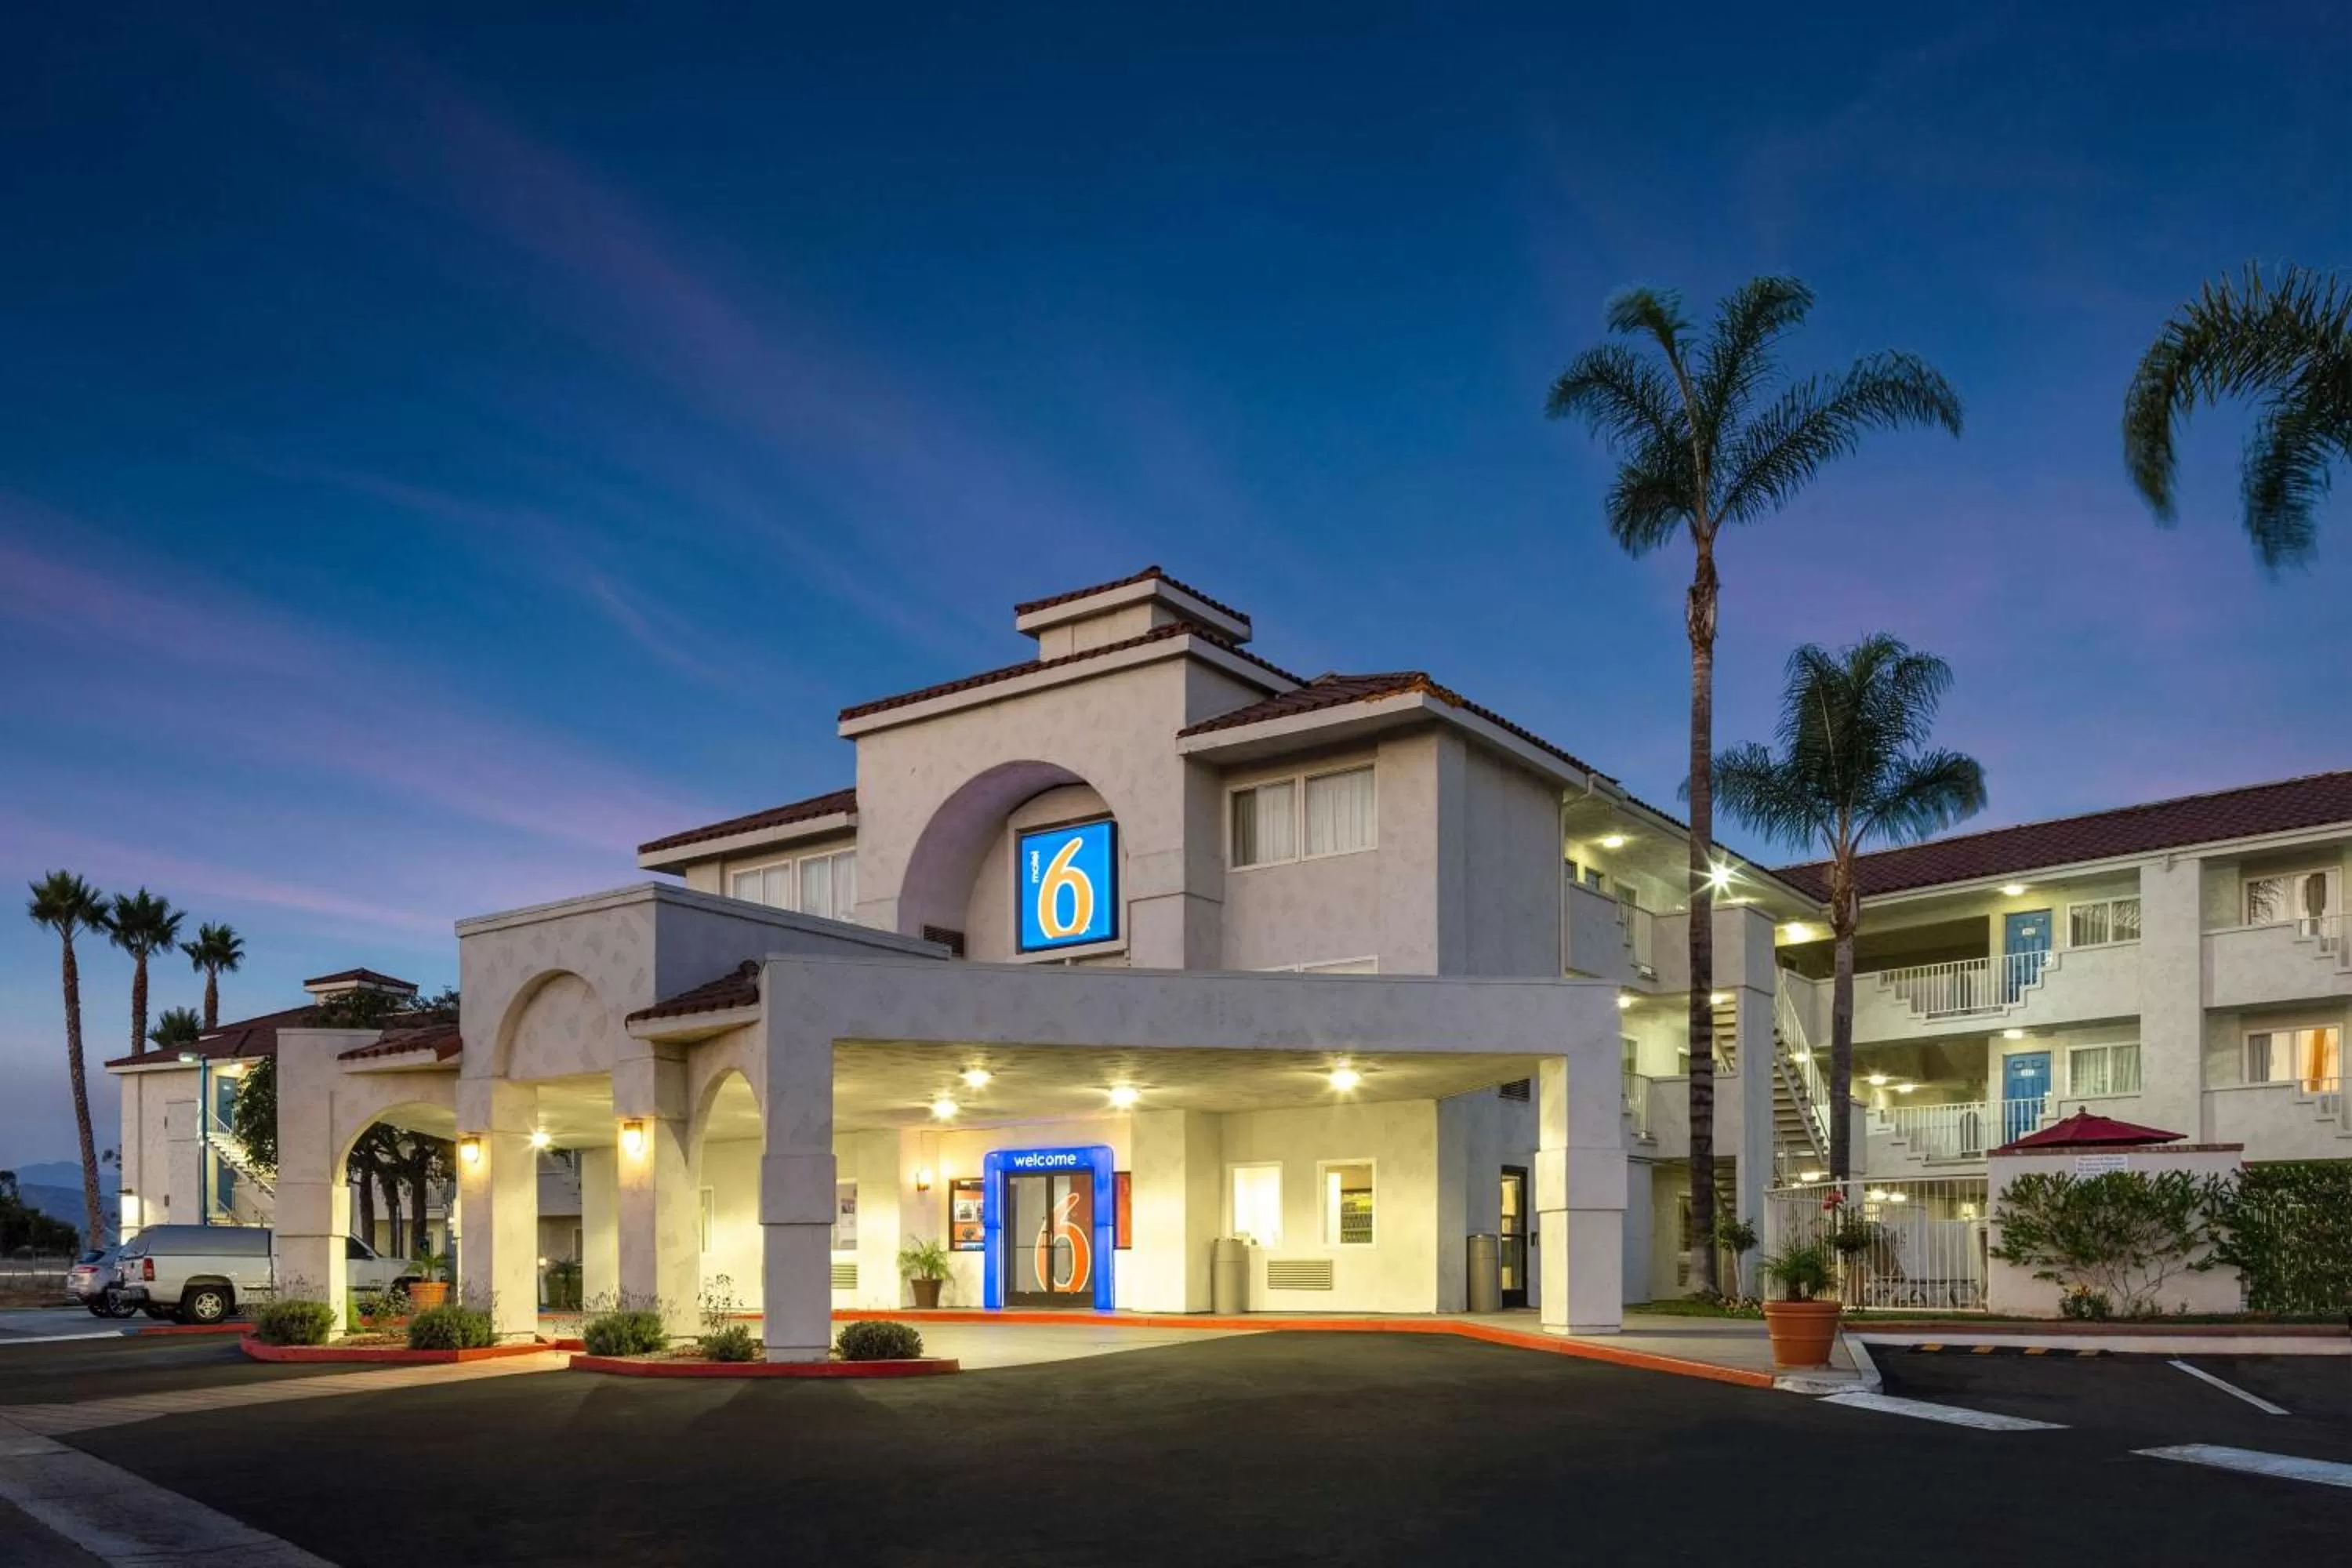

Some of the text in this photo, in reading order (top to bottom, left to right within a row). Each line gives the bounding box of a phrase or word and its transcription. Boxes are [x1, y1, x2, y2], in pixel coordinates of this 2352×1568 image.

[1038, 837, 1094, 939] 6
[1014, 1152, 1076, 1167] welcome
[1034, 1192, 1091, 1293] 6
